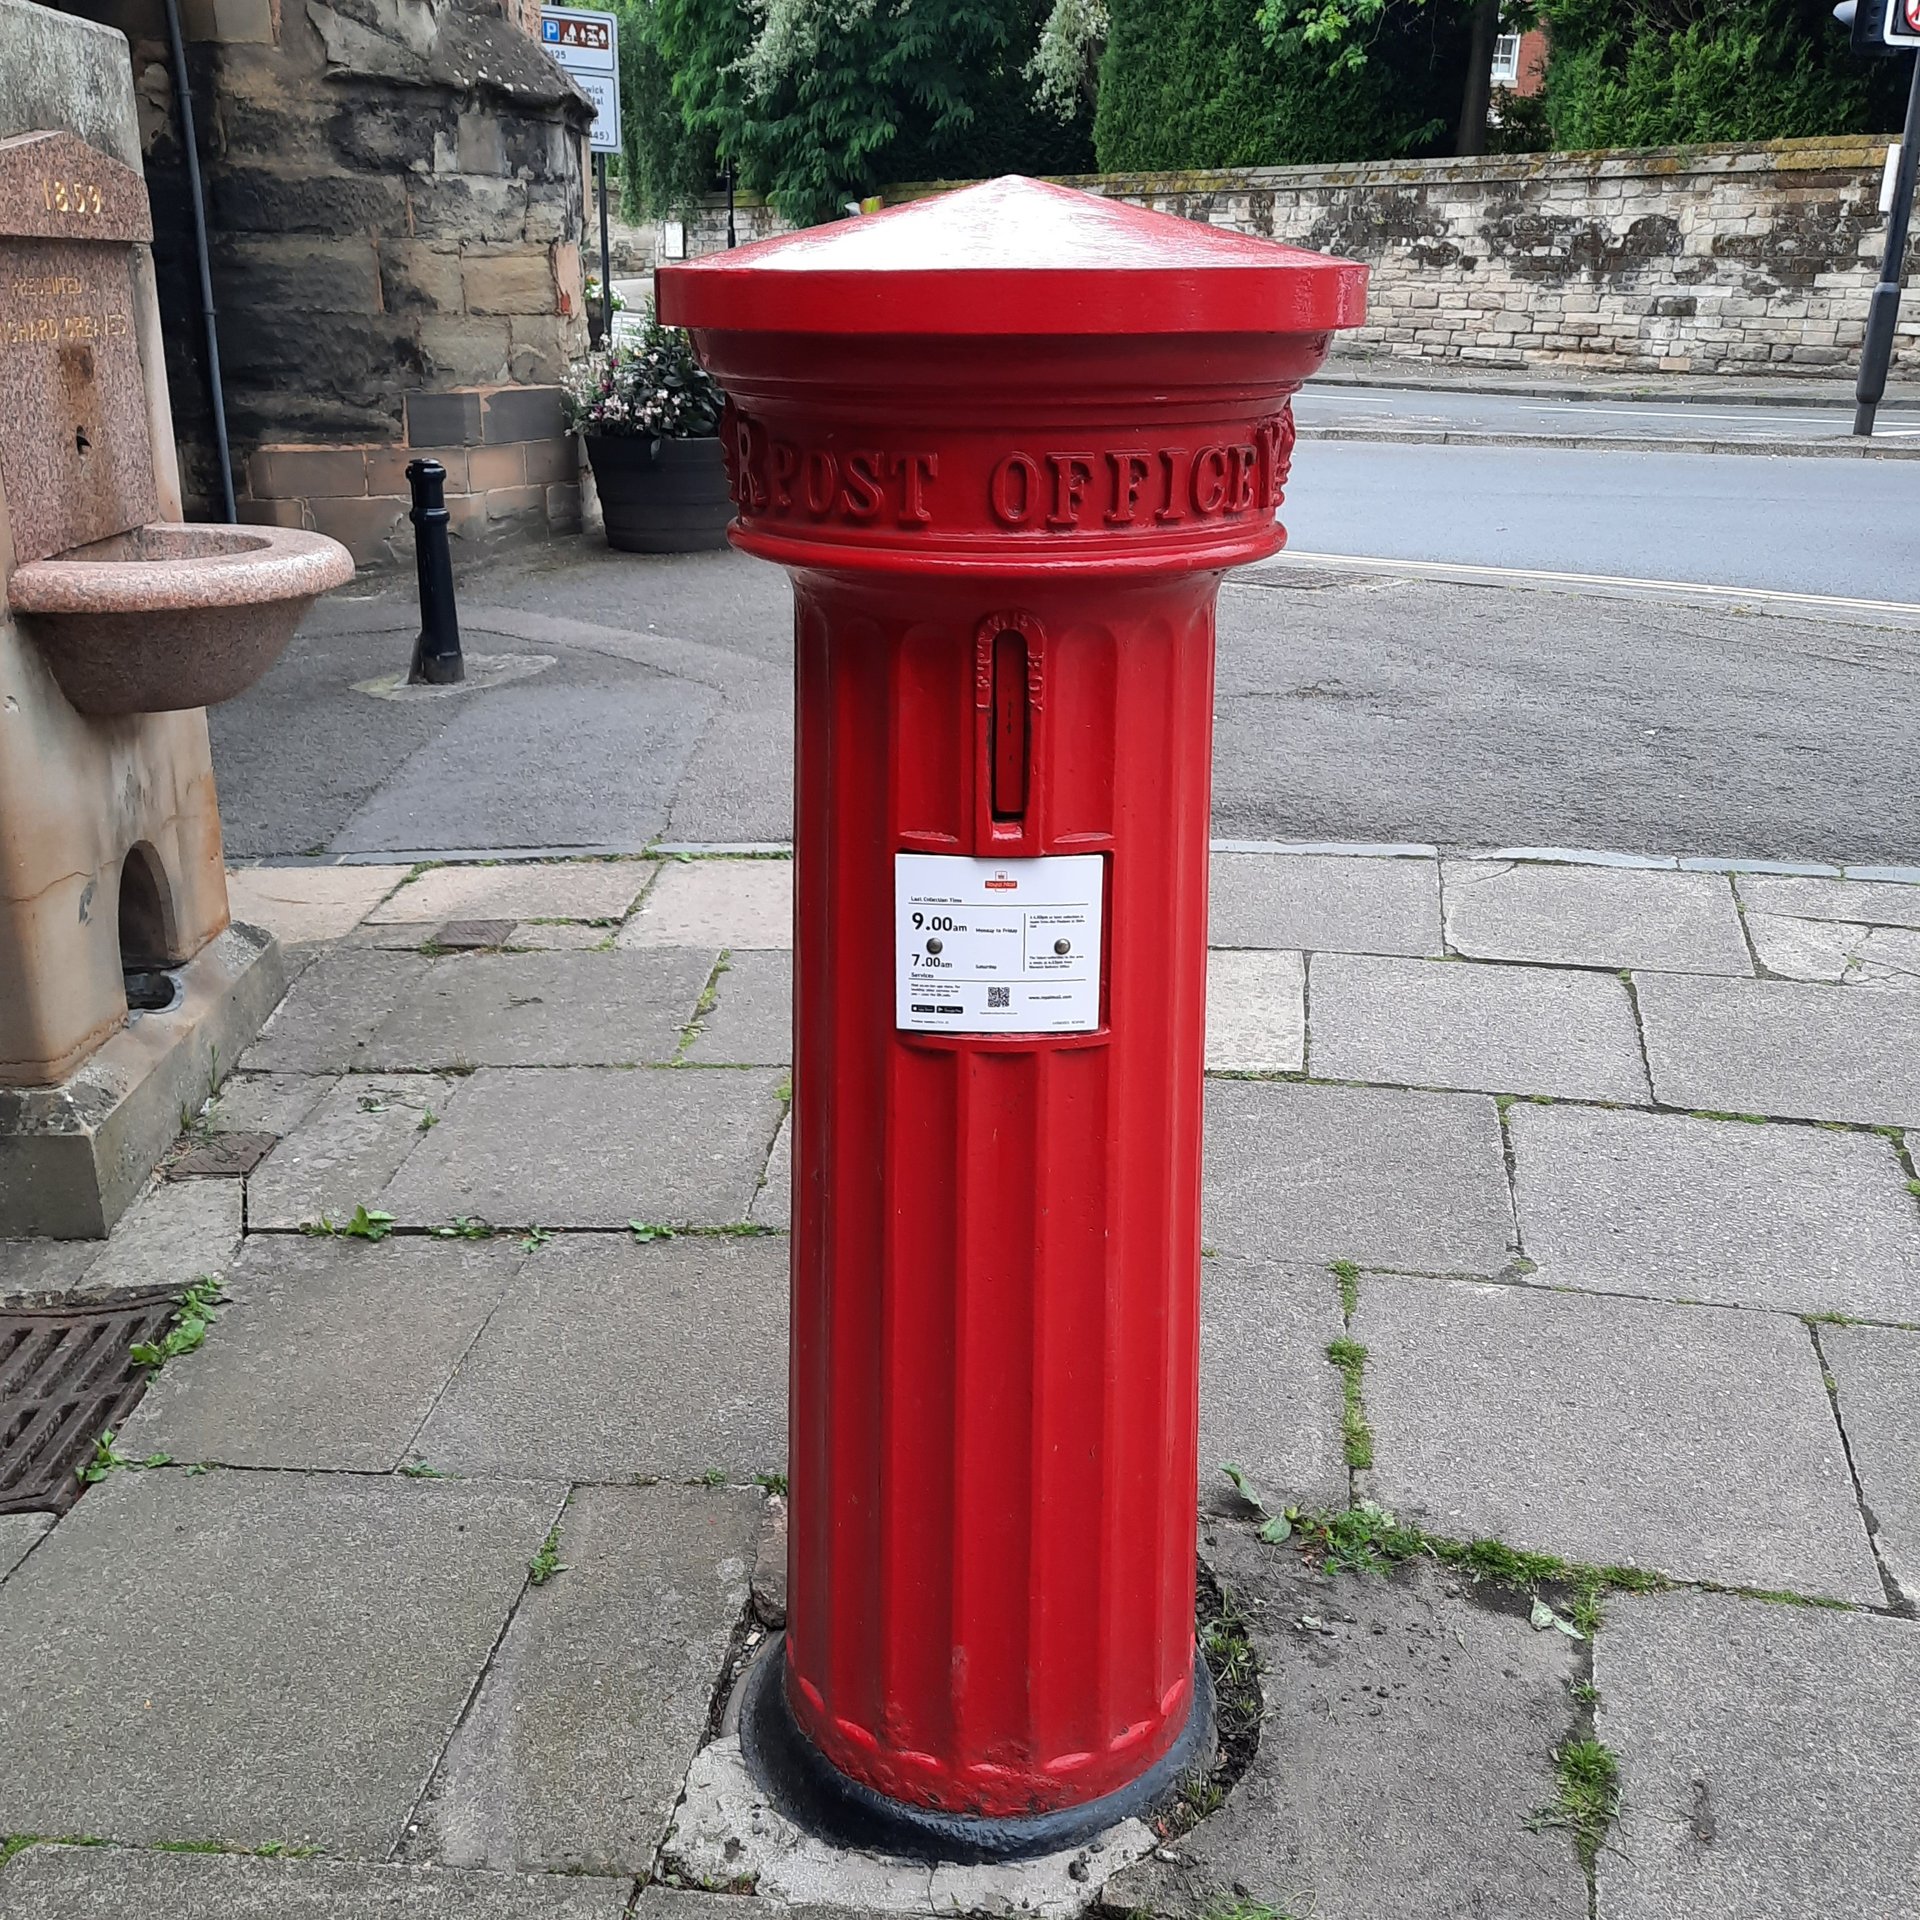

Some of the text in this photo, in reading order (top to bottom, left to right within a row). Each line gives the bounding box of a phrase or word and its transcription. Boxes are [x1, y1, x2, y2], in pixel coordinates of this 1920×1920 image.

[43, 179, 101, 214] 1859
[766, 440, 938, 523] POST
[991, 444, 1258, 525] OFFICE
[911, 912, 967, 932] 9.00am
[911, 954, 953, 968] 7.00am
